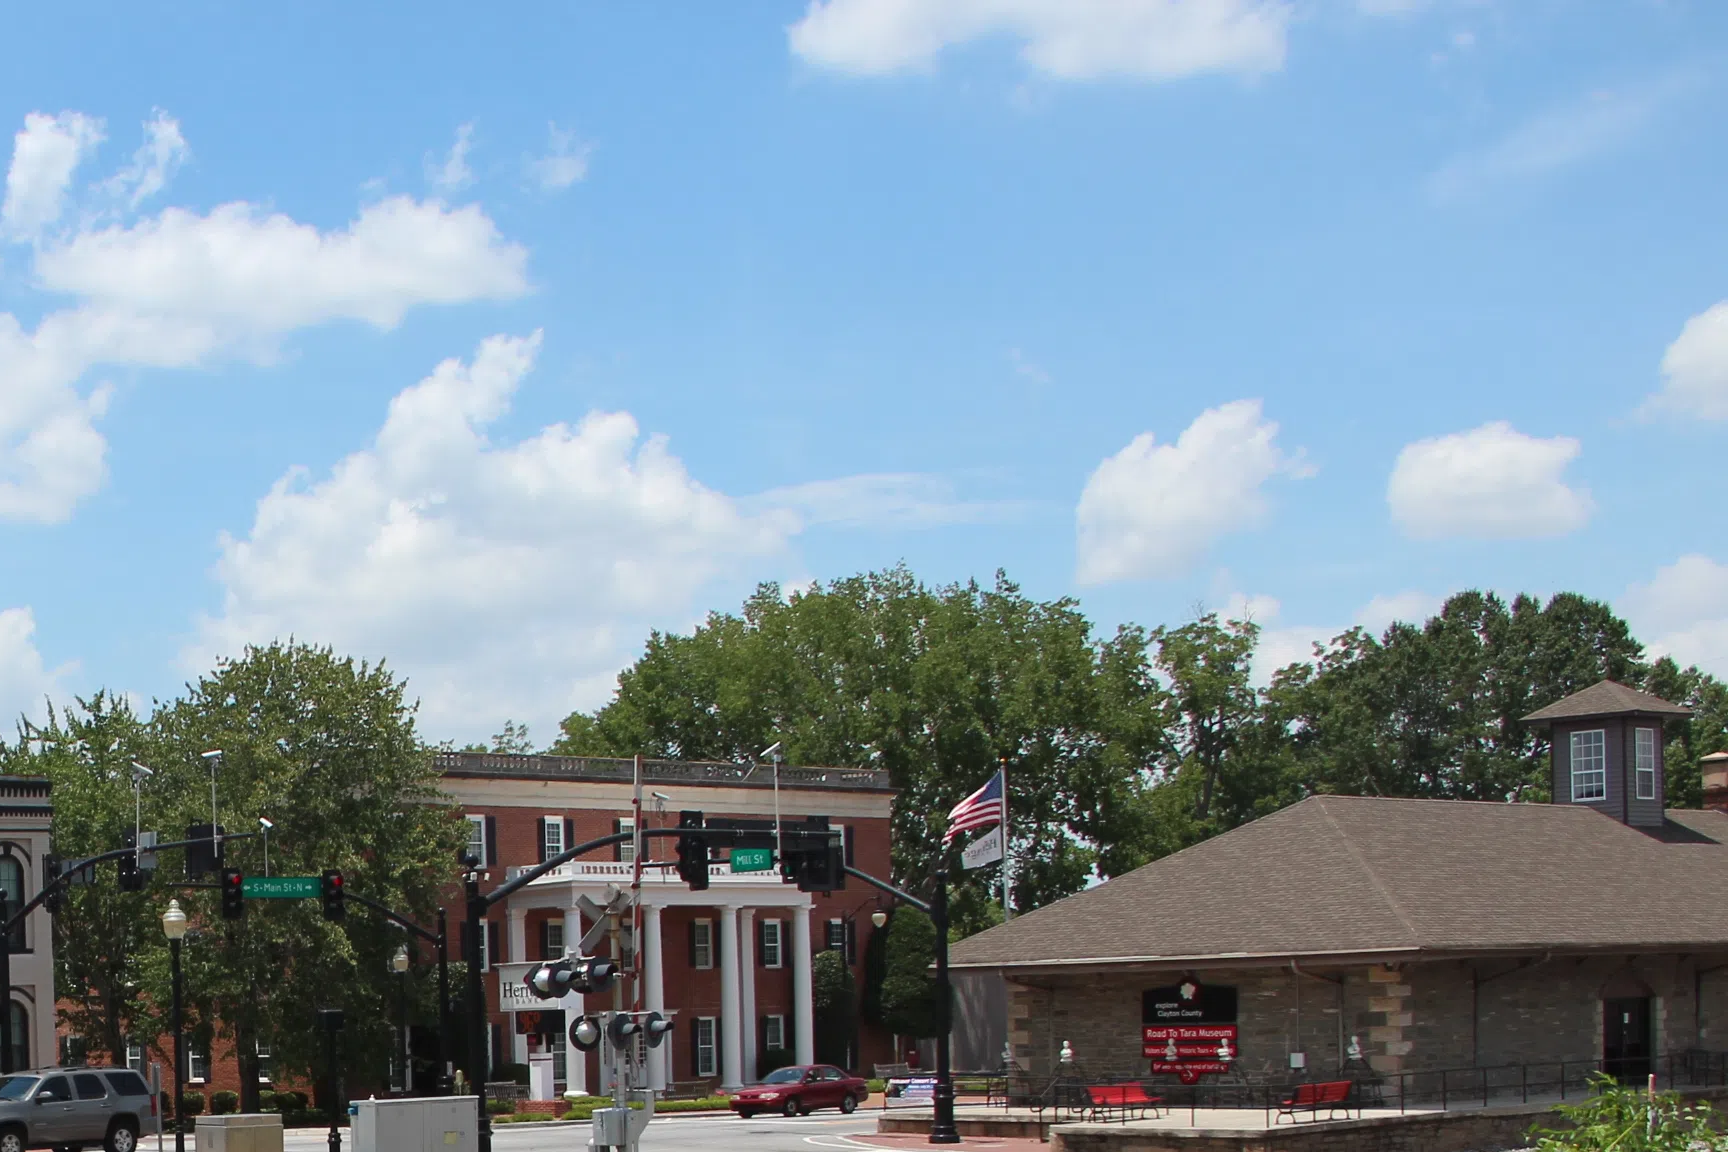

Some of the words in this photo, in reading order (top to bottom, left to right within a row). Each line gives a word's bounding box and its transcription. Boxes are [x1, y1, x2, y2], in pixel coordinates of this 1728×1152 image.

[736, 855, 752, 865] Mill
[753, 854, 764, 864] St
[1155, 1002, 1178, 1010] explore
[1157, 1010, 1180, 1018] Clayton
[1181, 1009, 1203, 1017] County
[1147, 1029, 1167, 1038] Road
[1168, 1028, 1178, 1037] To
[1180, 1028, 1197, 1037] Tara
[1198, 1028, 1232, 1037] Museum
